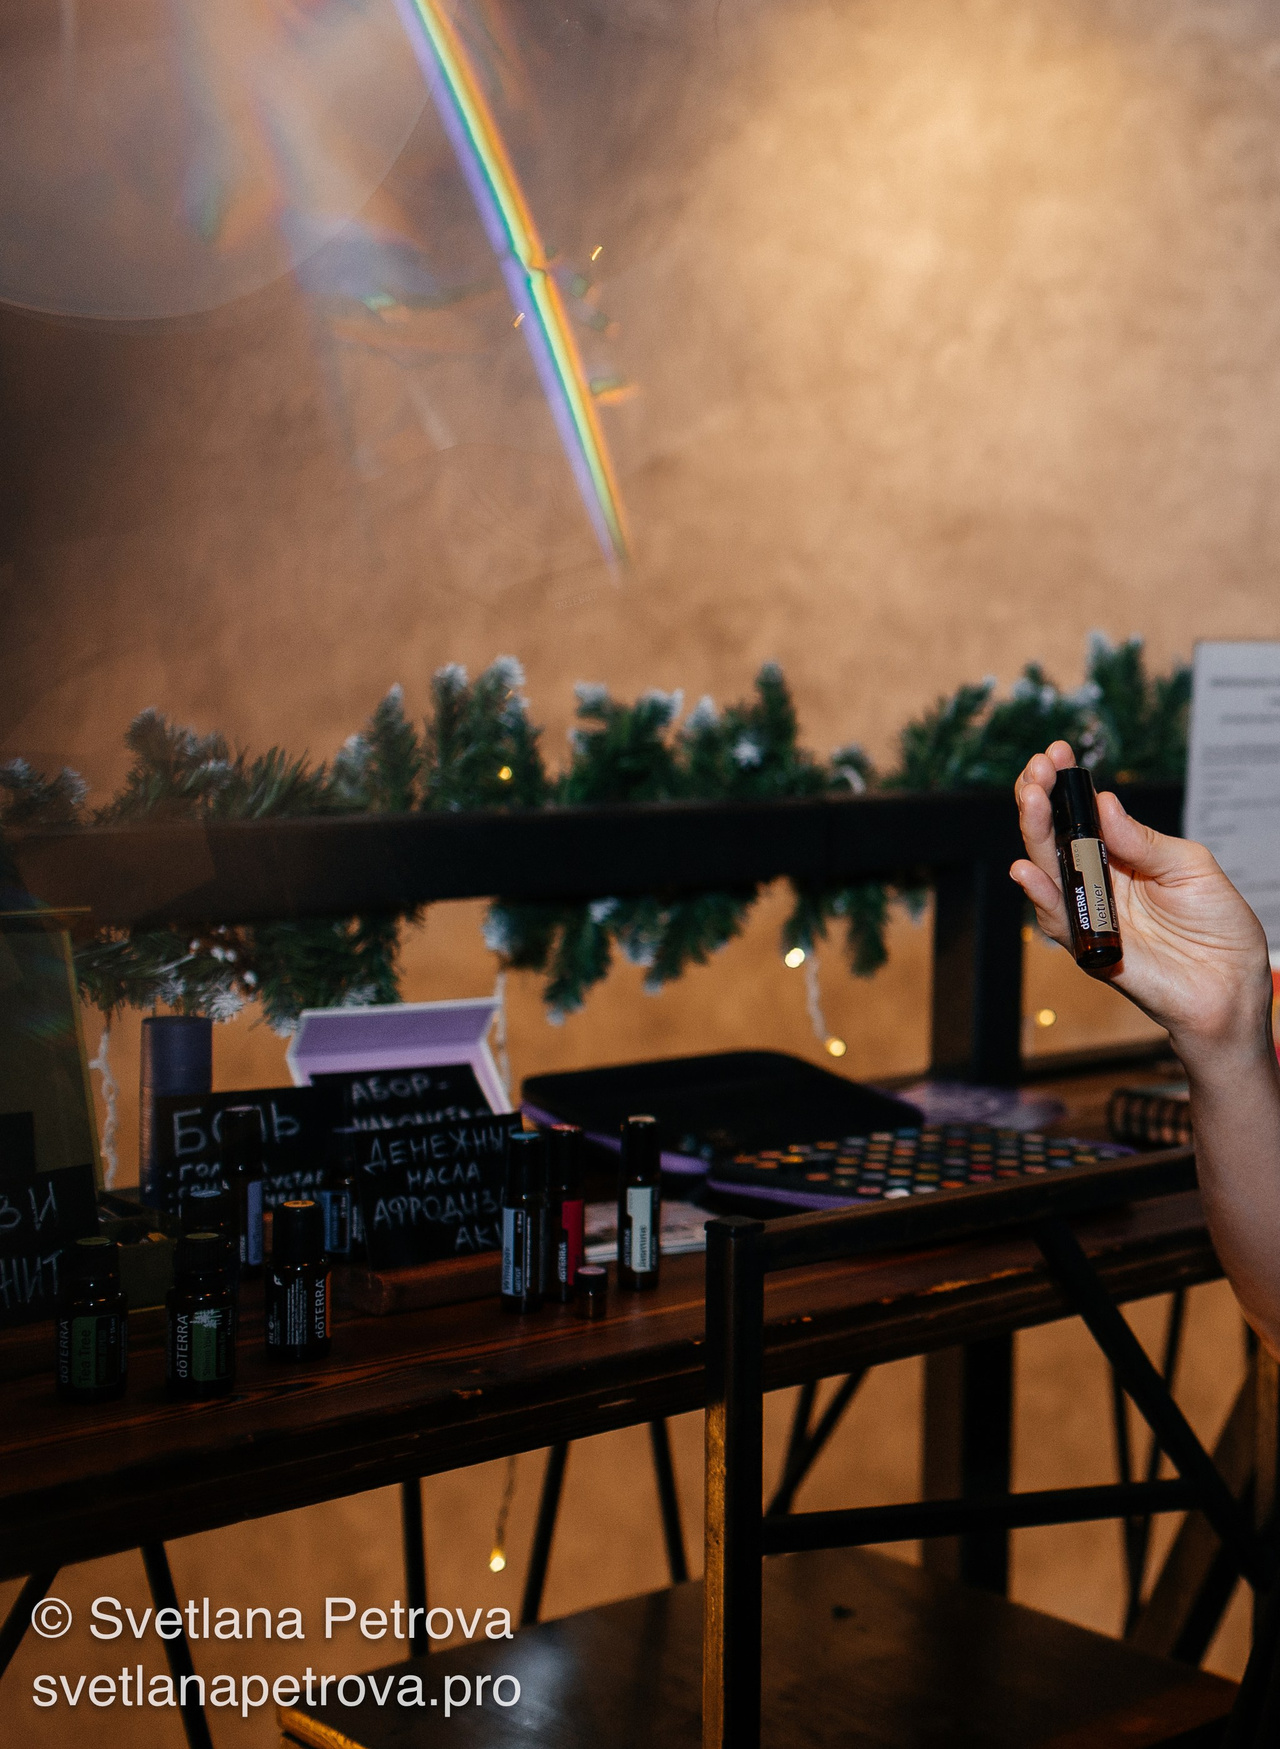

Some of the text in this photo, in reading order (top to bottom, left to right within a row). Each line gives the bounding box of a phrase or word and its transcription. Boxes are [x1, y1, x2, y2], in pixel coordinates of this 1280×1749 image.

[1093, 884, 1108, 928] Vetiver
[314, 1278, 325, 1339] dōTERRA
[78, 1330, 91, 1383] Tea Tree
[176, 1313, 189, 1379] dōTERRA
